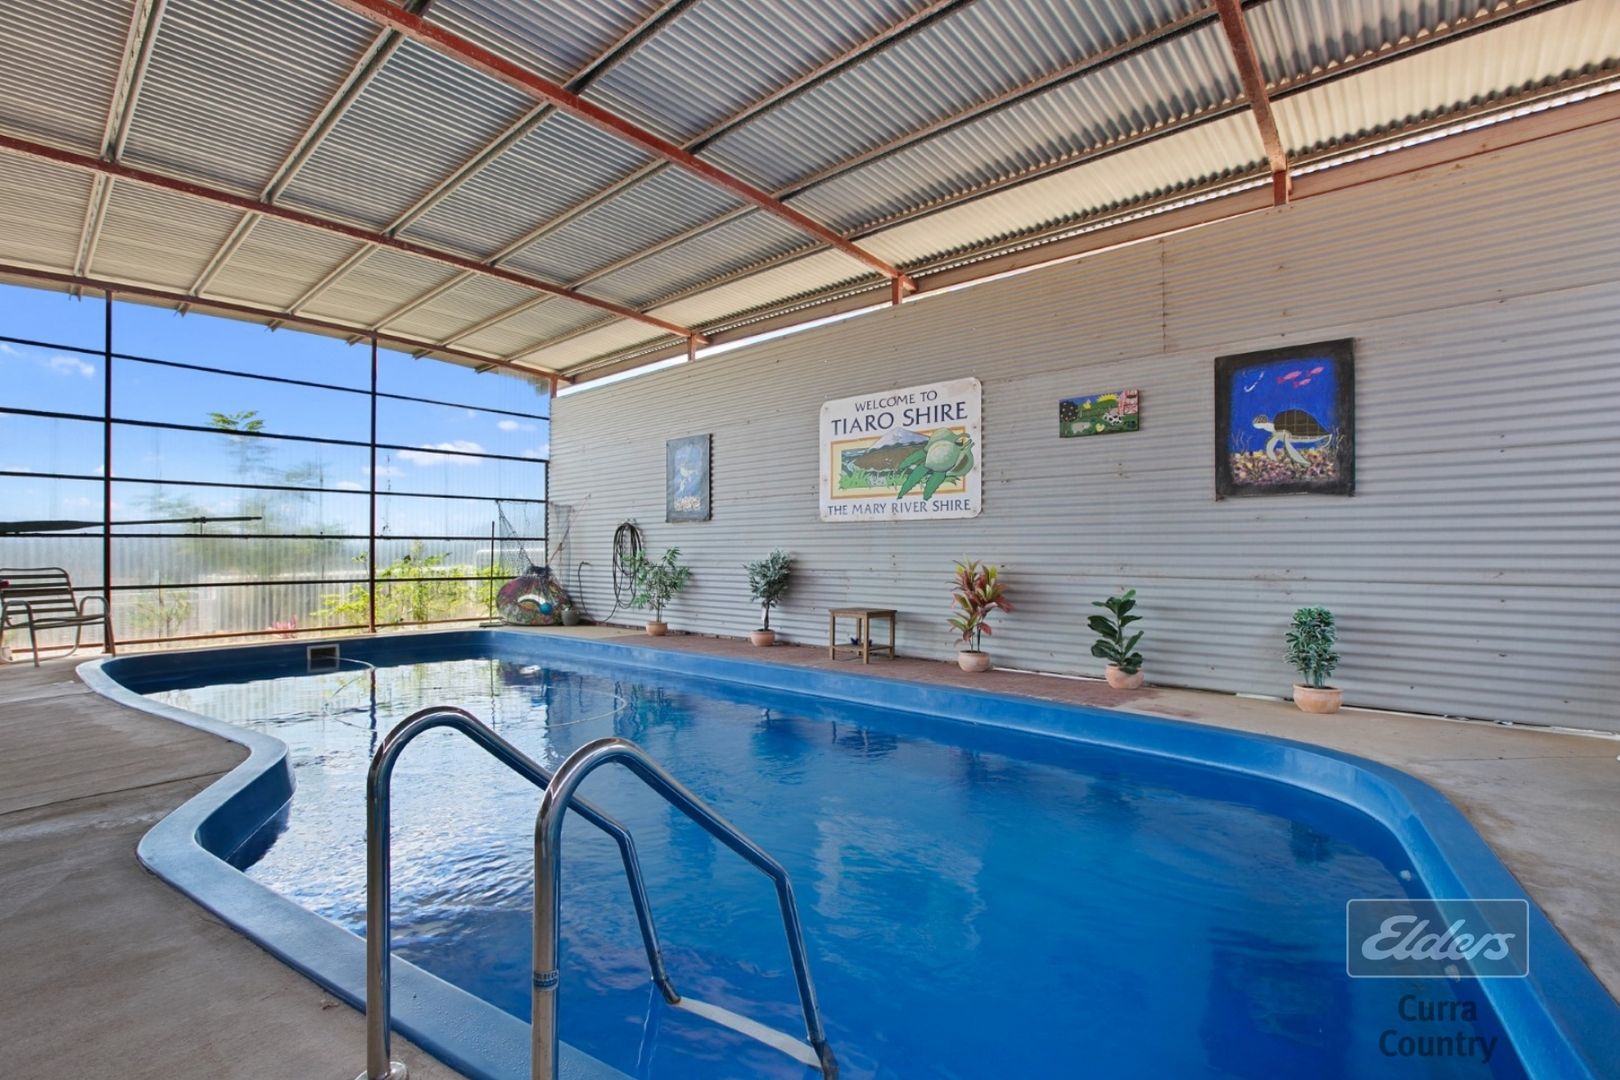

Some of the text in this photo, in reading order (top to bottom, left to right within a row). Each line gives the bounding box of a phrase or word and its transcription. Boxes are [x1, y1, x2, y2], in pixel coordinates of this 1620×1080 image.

[855, 390, 938, 412] WELCOME TO
[831, 401, 968, 436] TIARO SHIRE
[827, 499, 971, 516] THE MARY RIVER SHIRE
